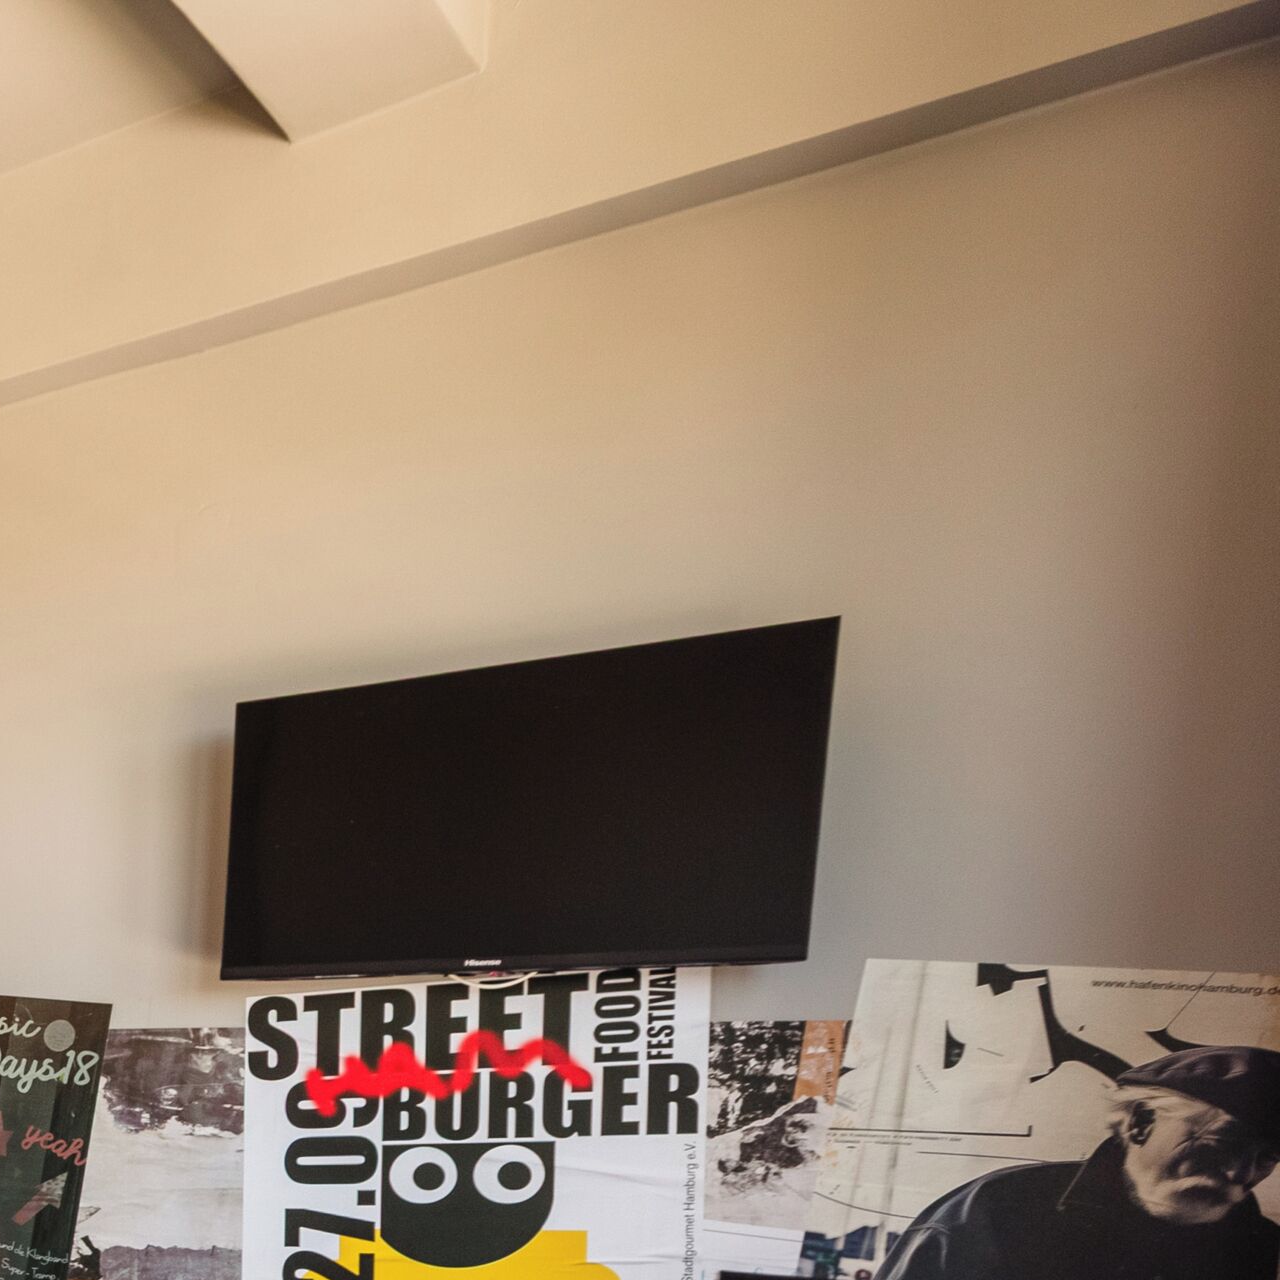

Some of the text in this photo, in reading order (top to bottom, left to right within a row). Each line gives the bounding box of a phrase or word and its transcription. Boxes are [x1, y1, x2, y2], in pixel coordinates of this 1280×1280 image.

[248, 973, 590, 1081] STREET
[594, 966, 641, 1062] FOOD
[646, 965, 676, 1060] FESTIVAL
[382, 1062, 700, 1141] BURGER
[20, 1124, 88, 1167] yeah
[682, 1163, 698, 1211] Hamburg
